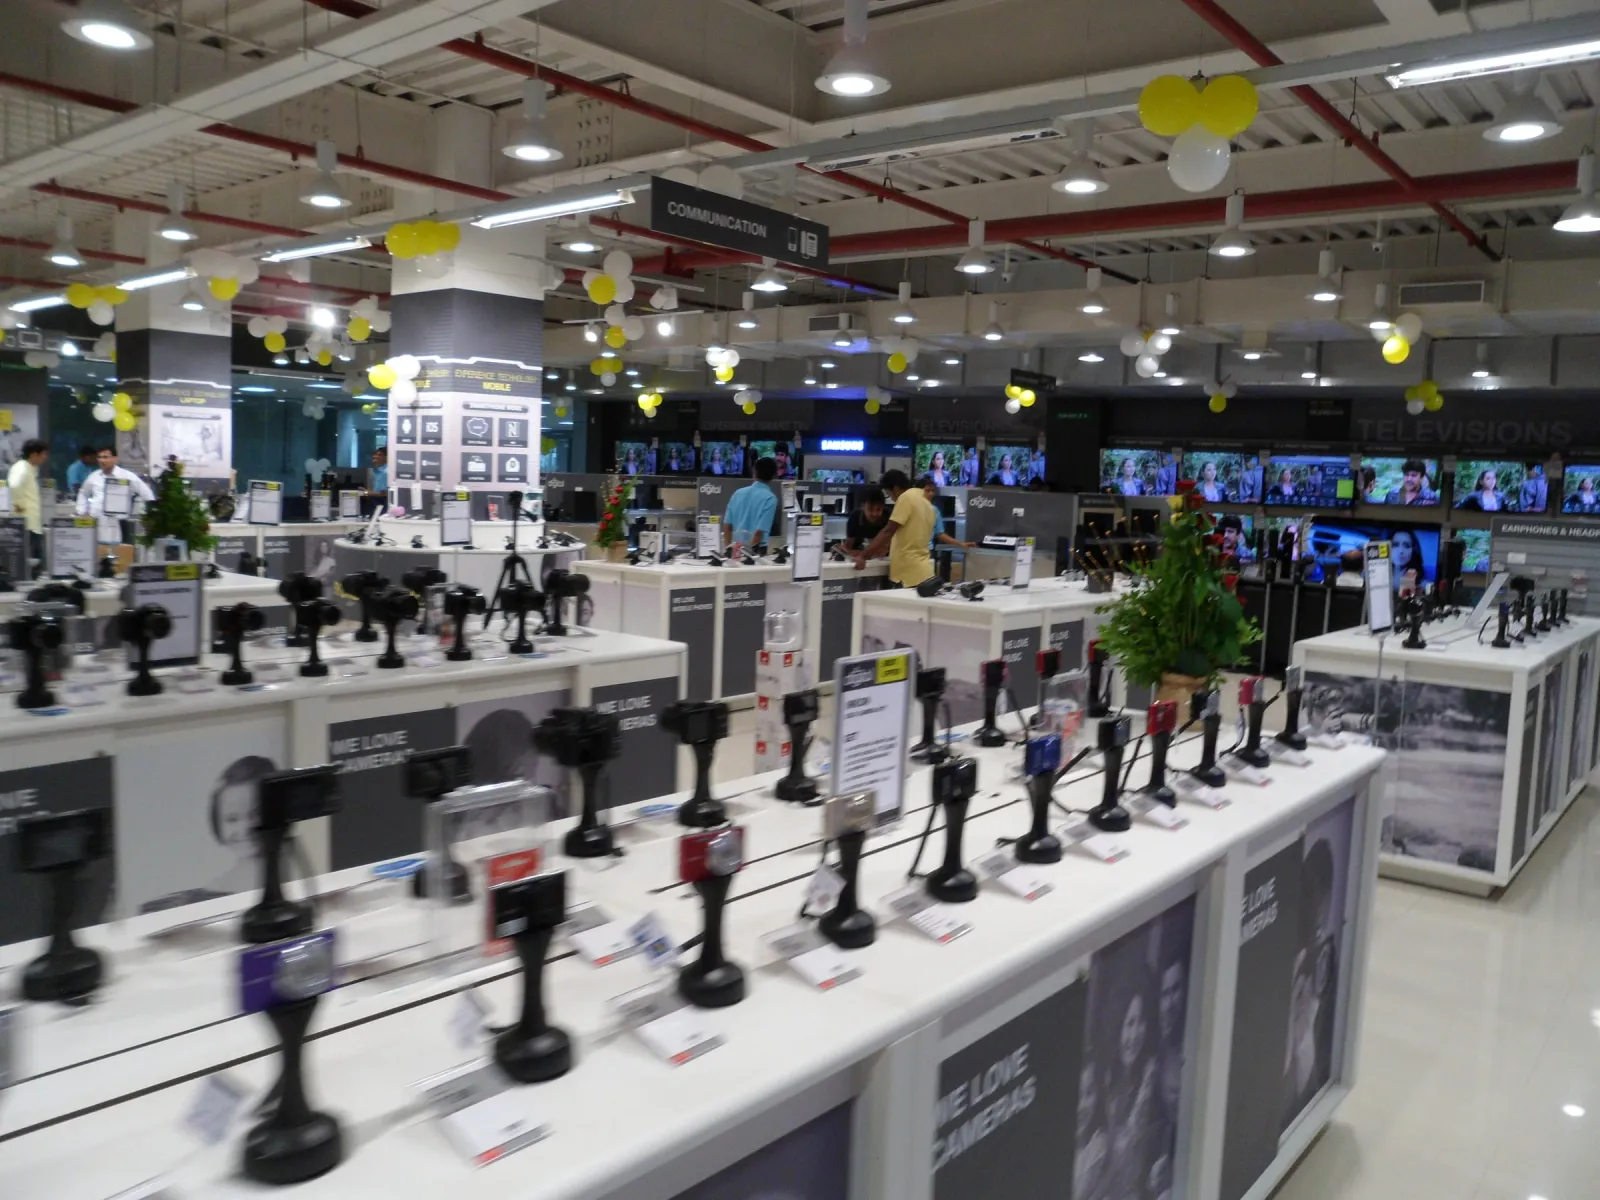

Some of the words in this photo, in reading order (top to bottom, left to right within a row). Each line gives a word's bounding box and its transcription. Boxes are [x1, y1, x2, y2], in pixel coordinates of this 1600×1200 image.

[667, 201, 767, 238] COMMUNICATION
[455, 369, 496, 380] EXPERIENCE
[497, 372, 537, 384] TECHNOLOGY
[482, 382, 511, 392] MOBILE
[1357, 418, 1573, 446] TELEVISIONS
[821, 439, 864, 451] SAMSUNG
[700, 482, 721, 496] digital
[969, 495, 996, 509] digital
[1501, 523, 1559, 536] EARPHONES
[1560, 527, 1567, 536] &
[1004, 640, 1013, 650] WE
[1013, 637, 1029, 648] LOVE
[595, 700, 618, 714] WE
[618, 695, 651, 711] LOVE
[331, 737, 360, 755] WE
[361, 730, 408, 750] LOVE
[1248, 876, 1276, 914] LOVE
[935, 1081, 968, 1128] WE
[970, 1042, 1029, 1106] LOVE
[931, 1075, 1037, 1175] CAMERAS
